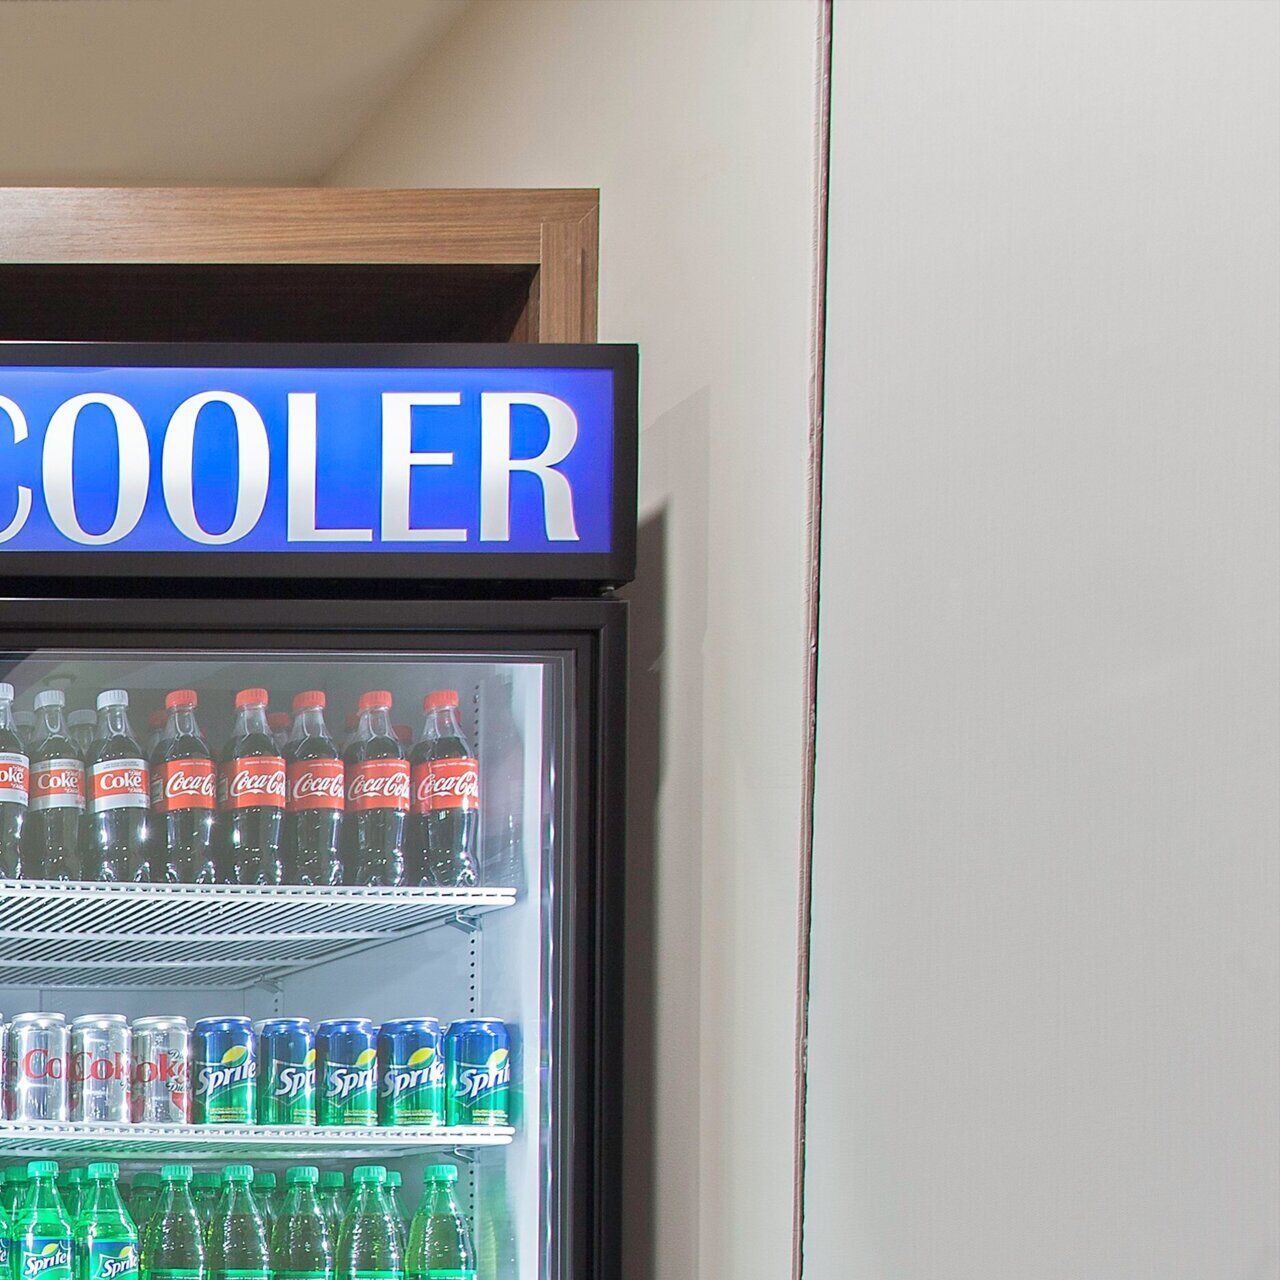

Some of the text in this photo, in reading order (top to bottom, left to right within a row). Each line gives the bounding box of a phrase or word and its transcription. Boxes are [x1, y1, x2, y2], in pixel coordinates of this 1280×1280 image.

[38, 771, 78, 791] Coke
[100, 771, 142, 792] Coke
[195, 1058, 256, 1097] Sprite
[380, 1060, 444, 1099] Sprite
[25, 1251, 67, 1277] Sprite
